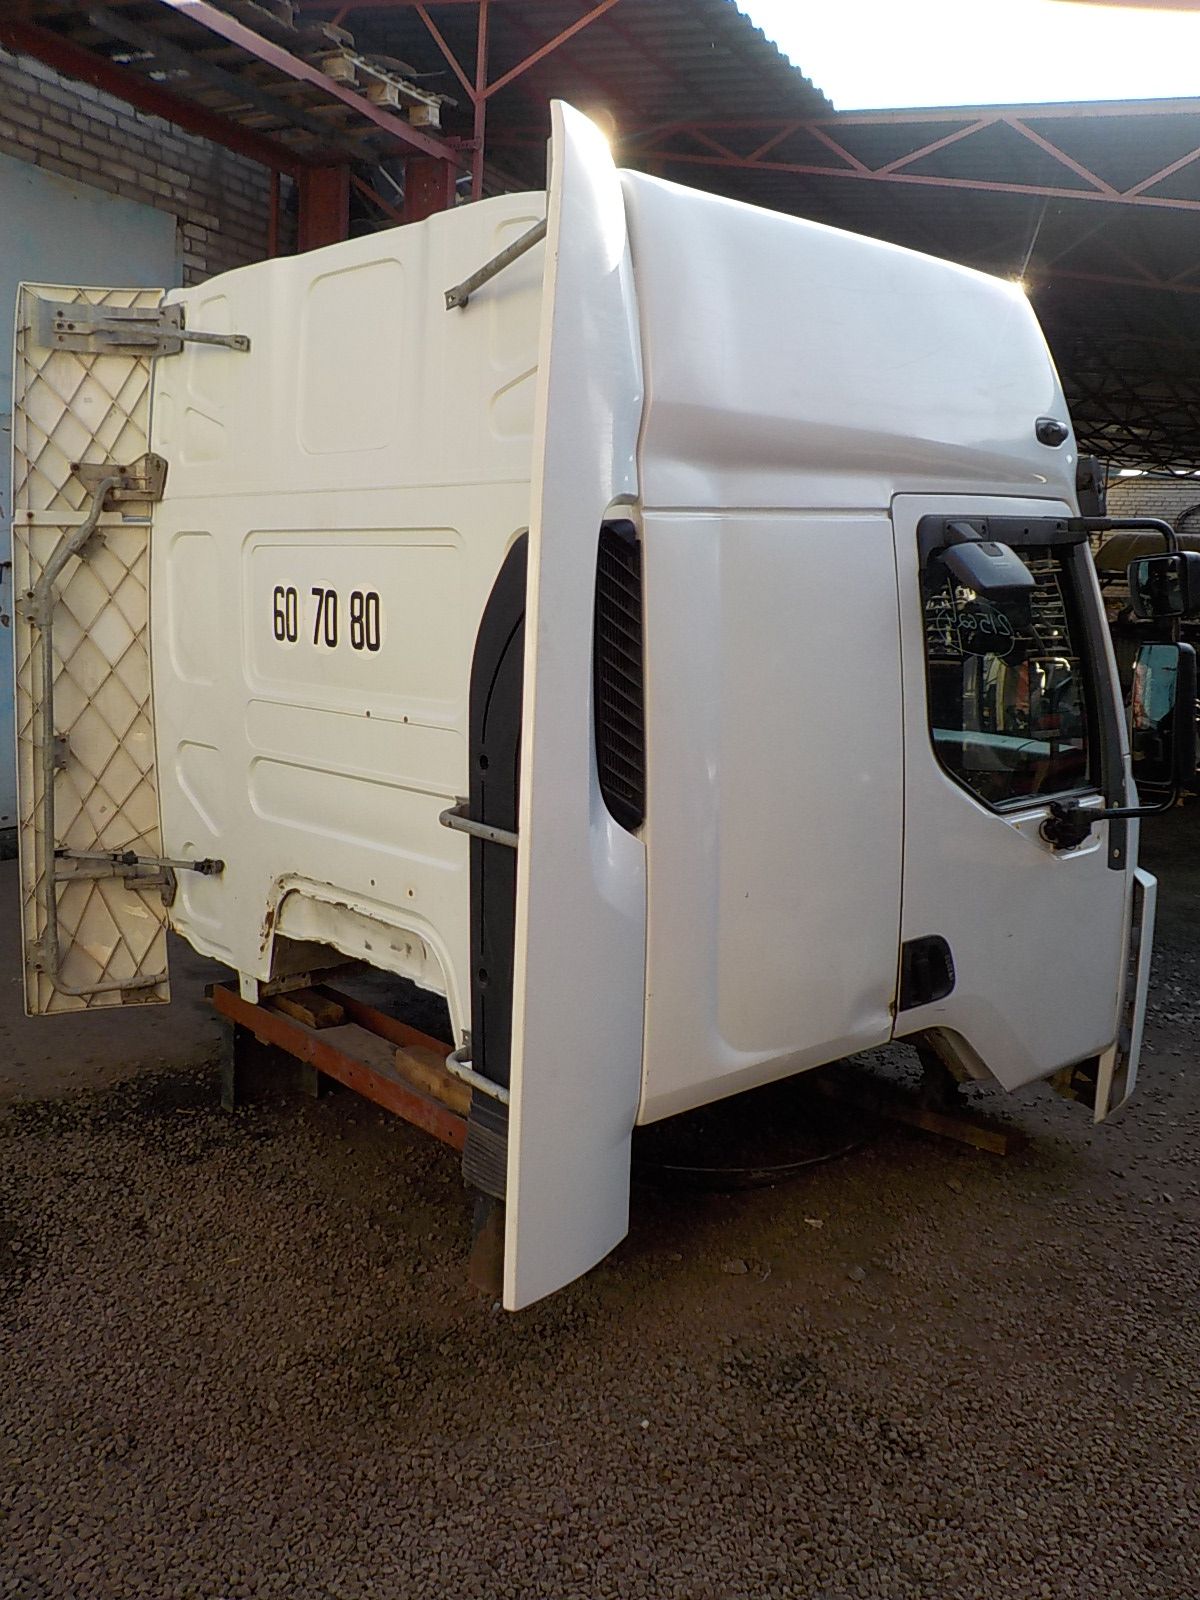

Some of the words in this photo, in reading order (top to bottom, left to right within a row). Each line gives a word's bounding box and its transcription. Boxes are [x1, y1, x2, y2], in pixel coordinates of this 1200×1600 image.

[273, 585, 298, 643] 60
[311, 587, 338, 648] 70
[350, 590, 381, 652] 80
